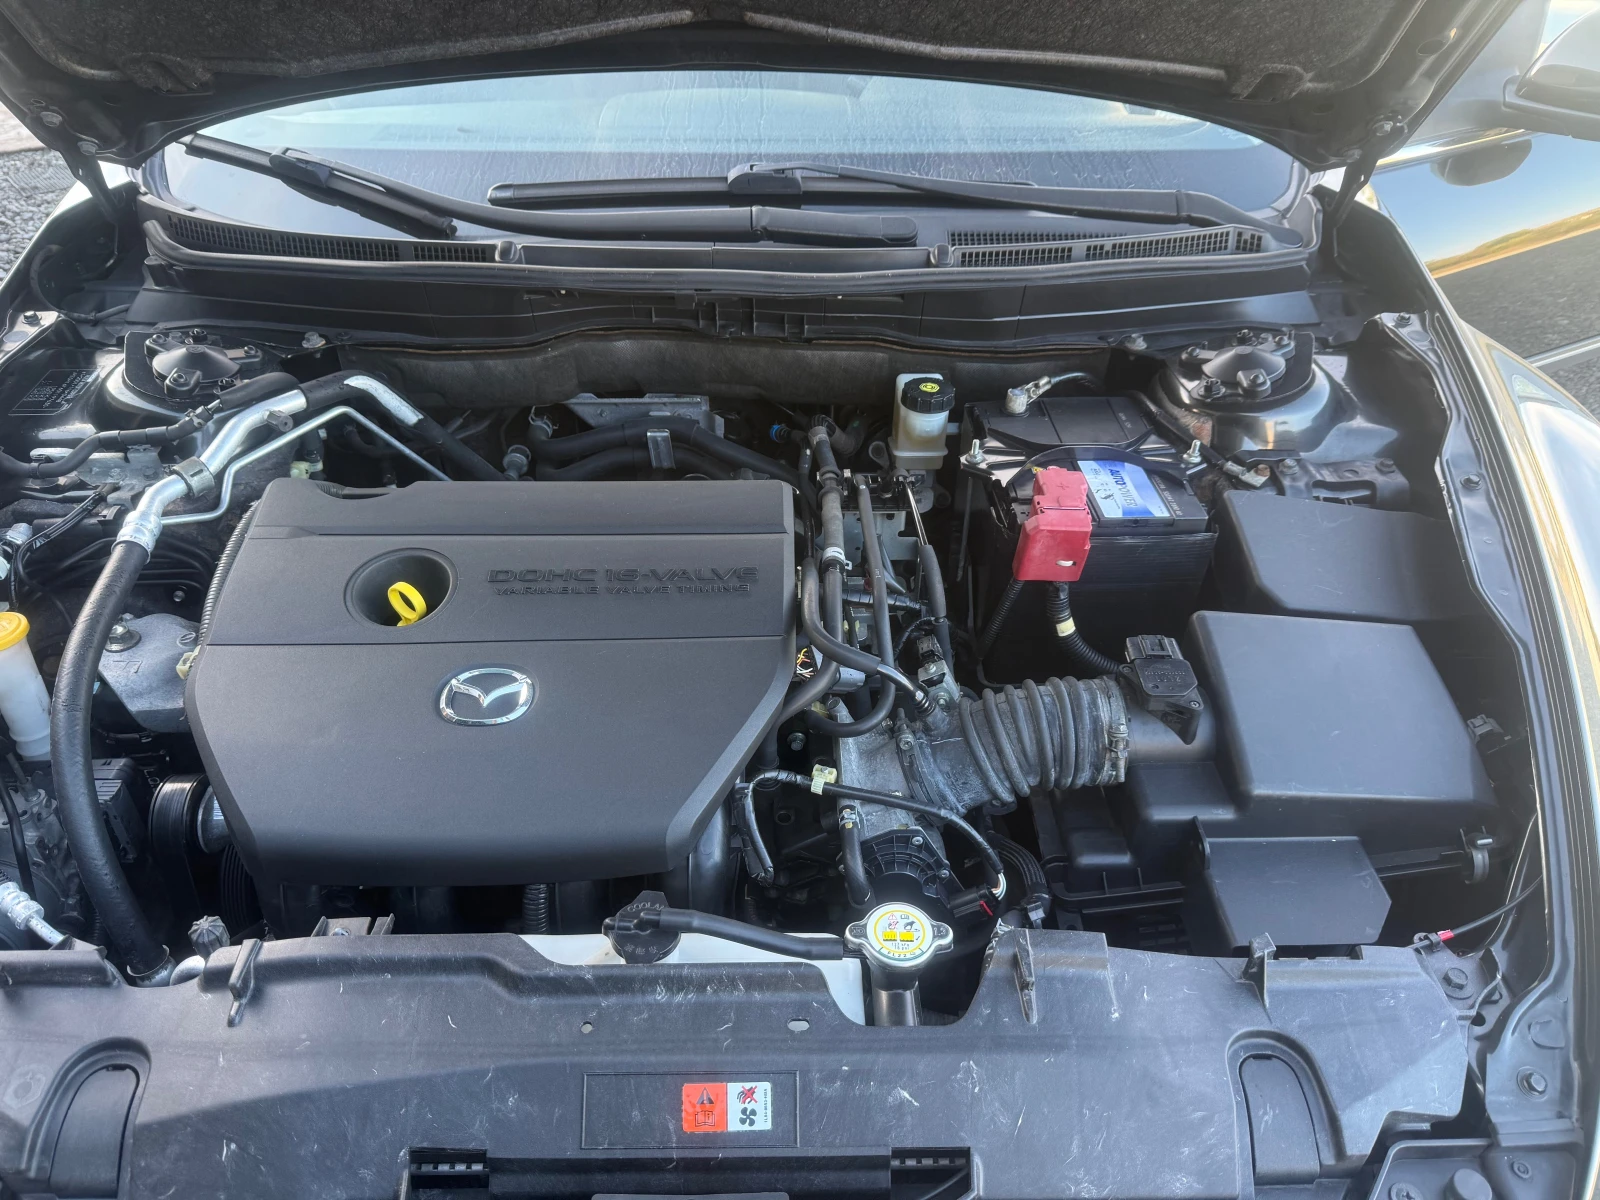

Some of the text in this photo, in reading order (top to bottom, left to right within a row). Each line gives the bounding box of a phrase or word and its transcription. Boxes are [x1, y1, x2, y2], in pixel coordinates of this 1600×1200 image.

[1108, 468, 1138, 508] AUTOPOWER
[487, 566, 759, 583] DOHC 16-VALVE
[493, 583, 750, 596] VARIABLE VALVE TIMING
